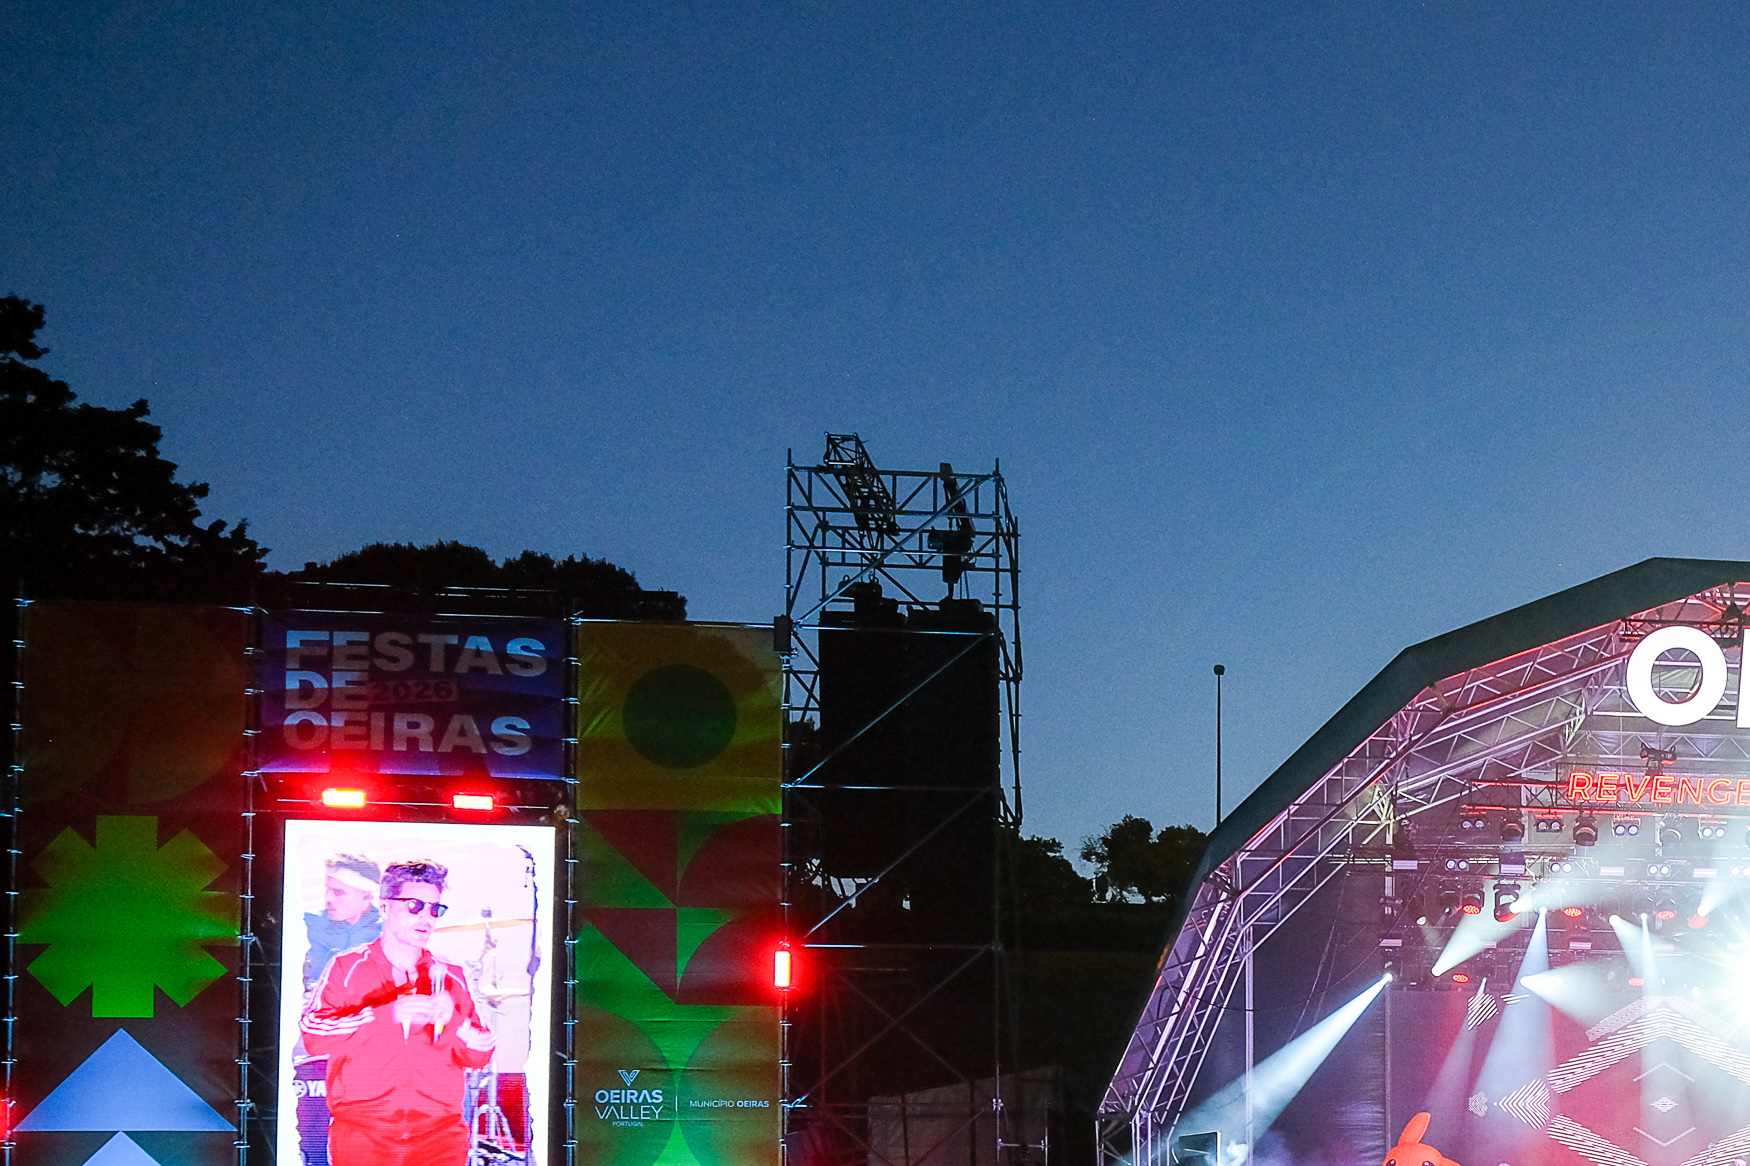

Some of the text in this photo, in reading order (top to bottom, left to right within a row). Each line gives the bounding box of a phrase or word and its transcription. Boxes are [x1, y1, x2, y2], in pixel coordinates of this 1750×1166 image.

[286, 630, 547, 677] FESTAS
[285, 670, 370, 710] DE
[283, 711, 532, 756] OEIRAS
[594, 1089, 663, 1104] OEIRAS
[736, 1100, 770, 1108] OEIRAS
[594, 1105, 663, 1120] VALLEY
